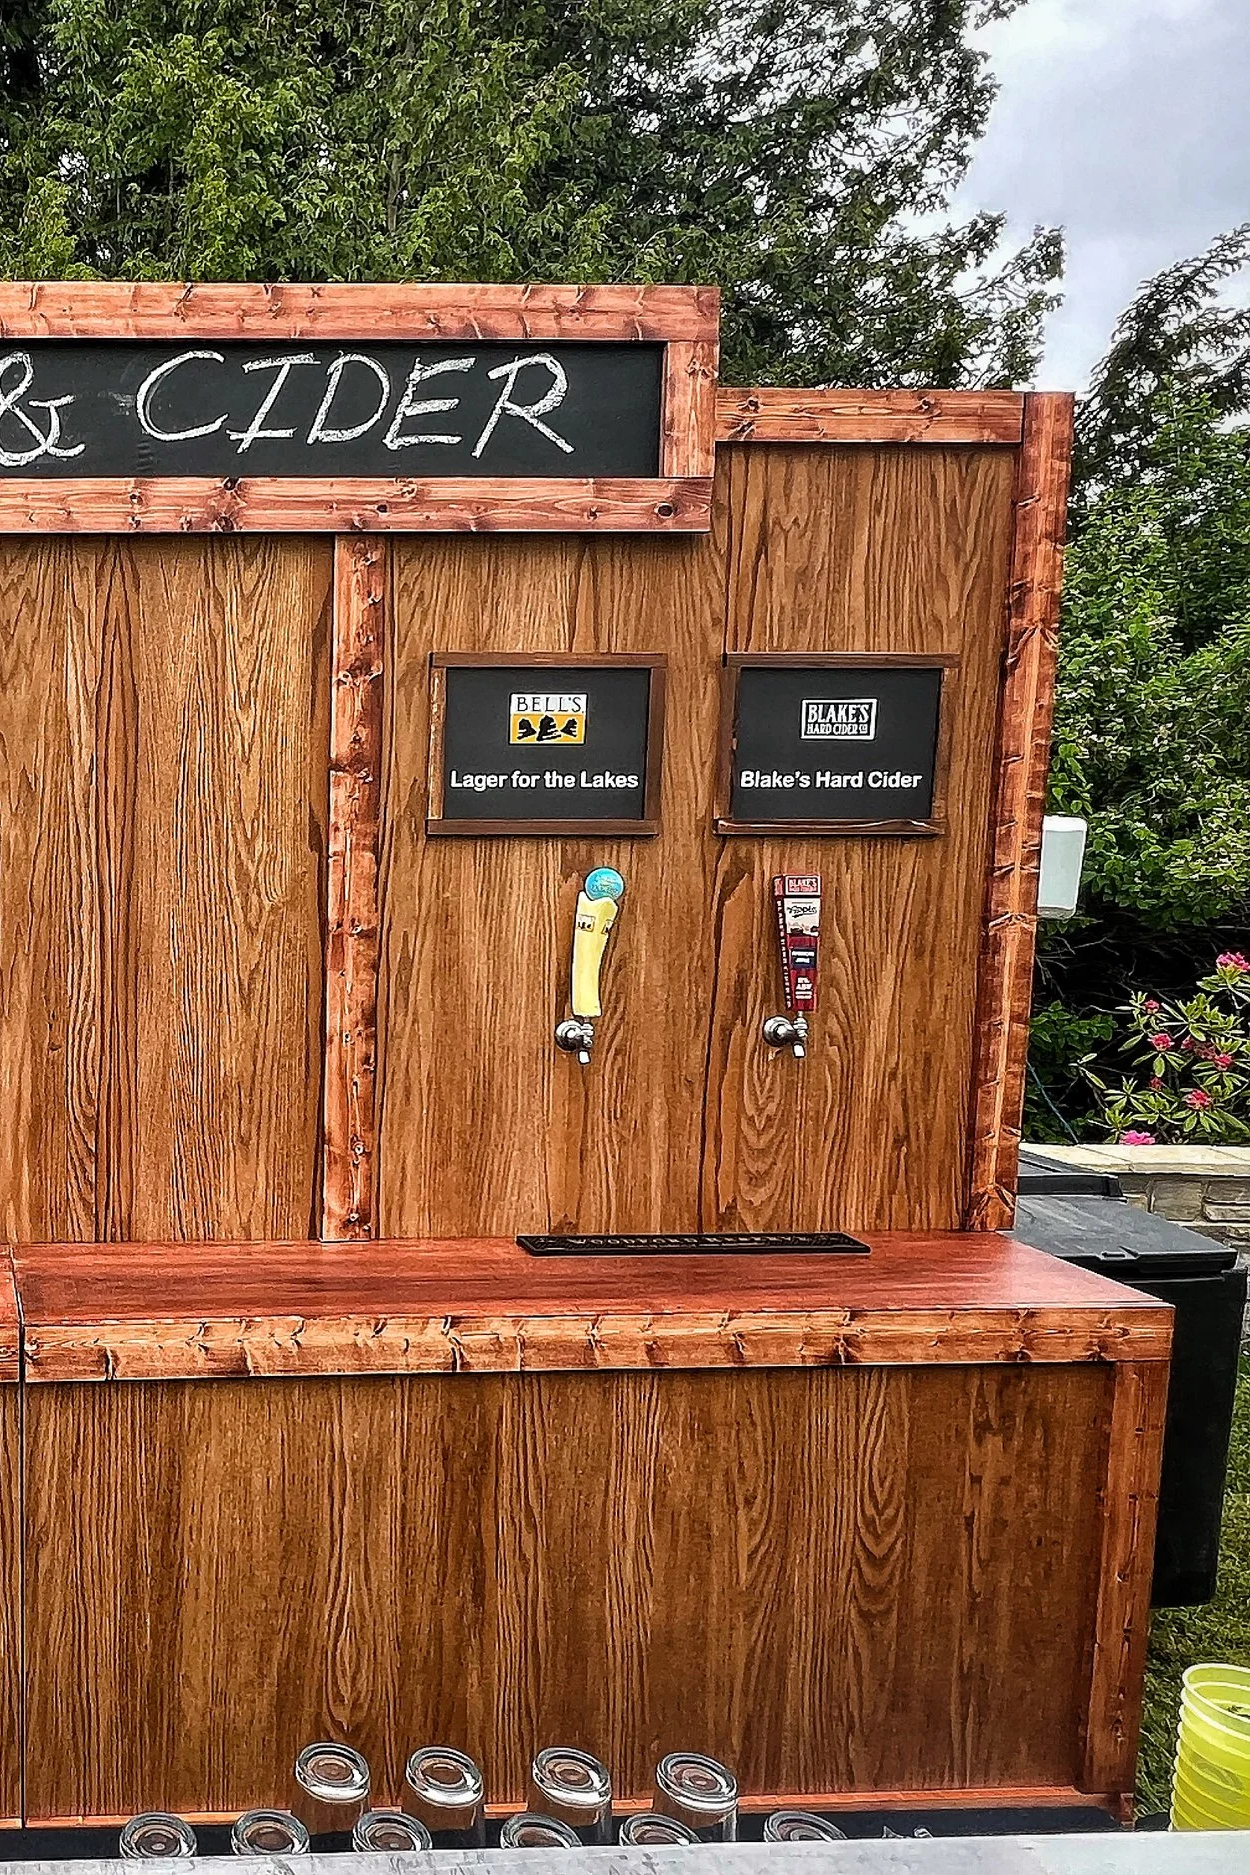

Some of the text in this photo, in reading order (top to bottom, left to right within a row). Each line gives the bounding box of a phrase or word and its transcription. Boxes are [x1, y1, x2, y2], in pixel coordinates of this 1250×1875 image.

[136, 349, 575, 458] CIDER
[516, 696, 582, 713] BELL'S
[806, 723, 832, 735] HARD
[832, 723, 858, 735] CIDER
[450, 770, 639, 792] Lager for the Lakes
[739, 770, 923, 788] Blake's Hard Cider
